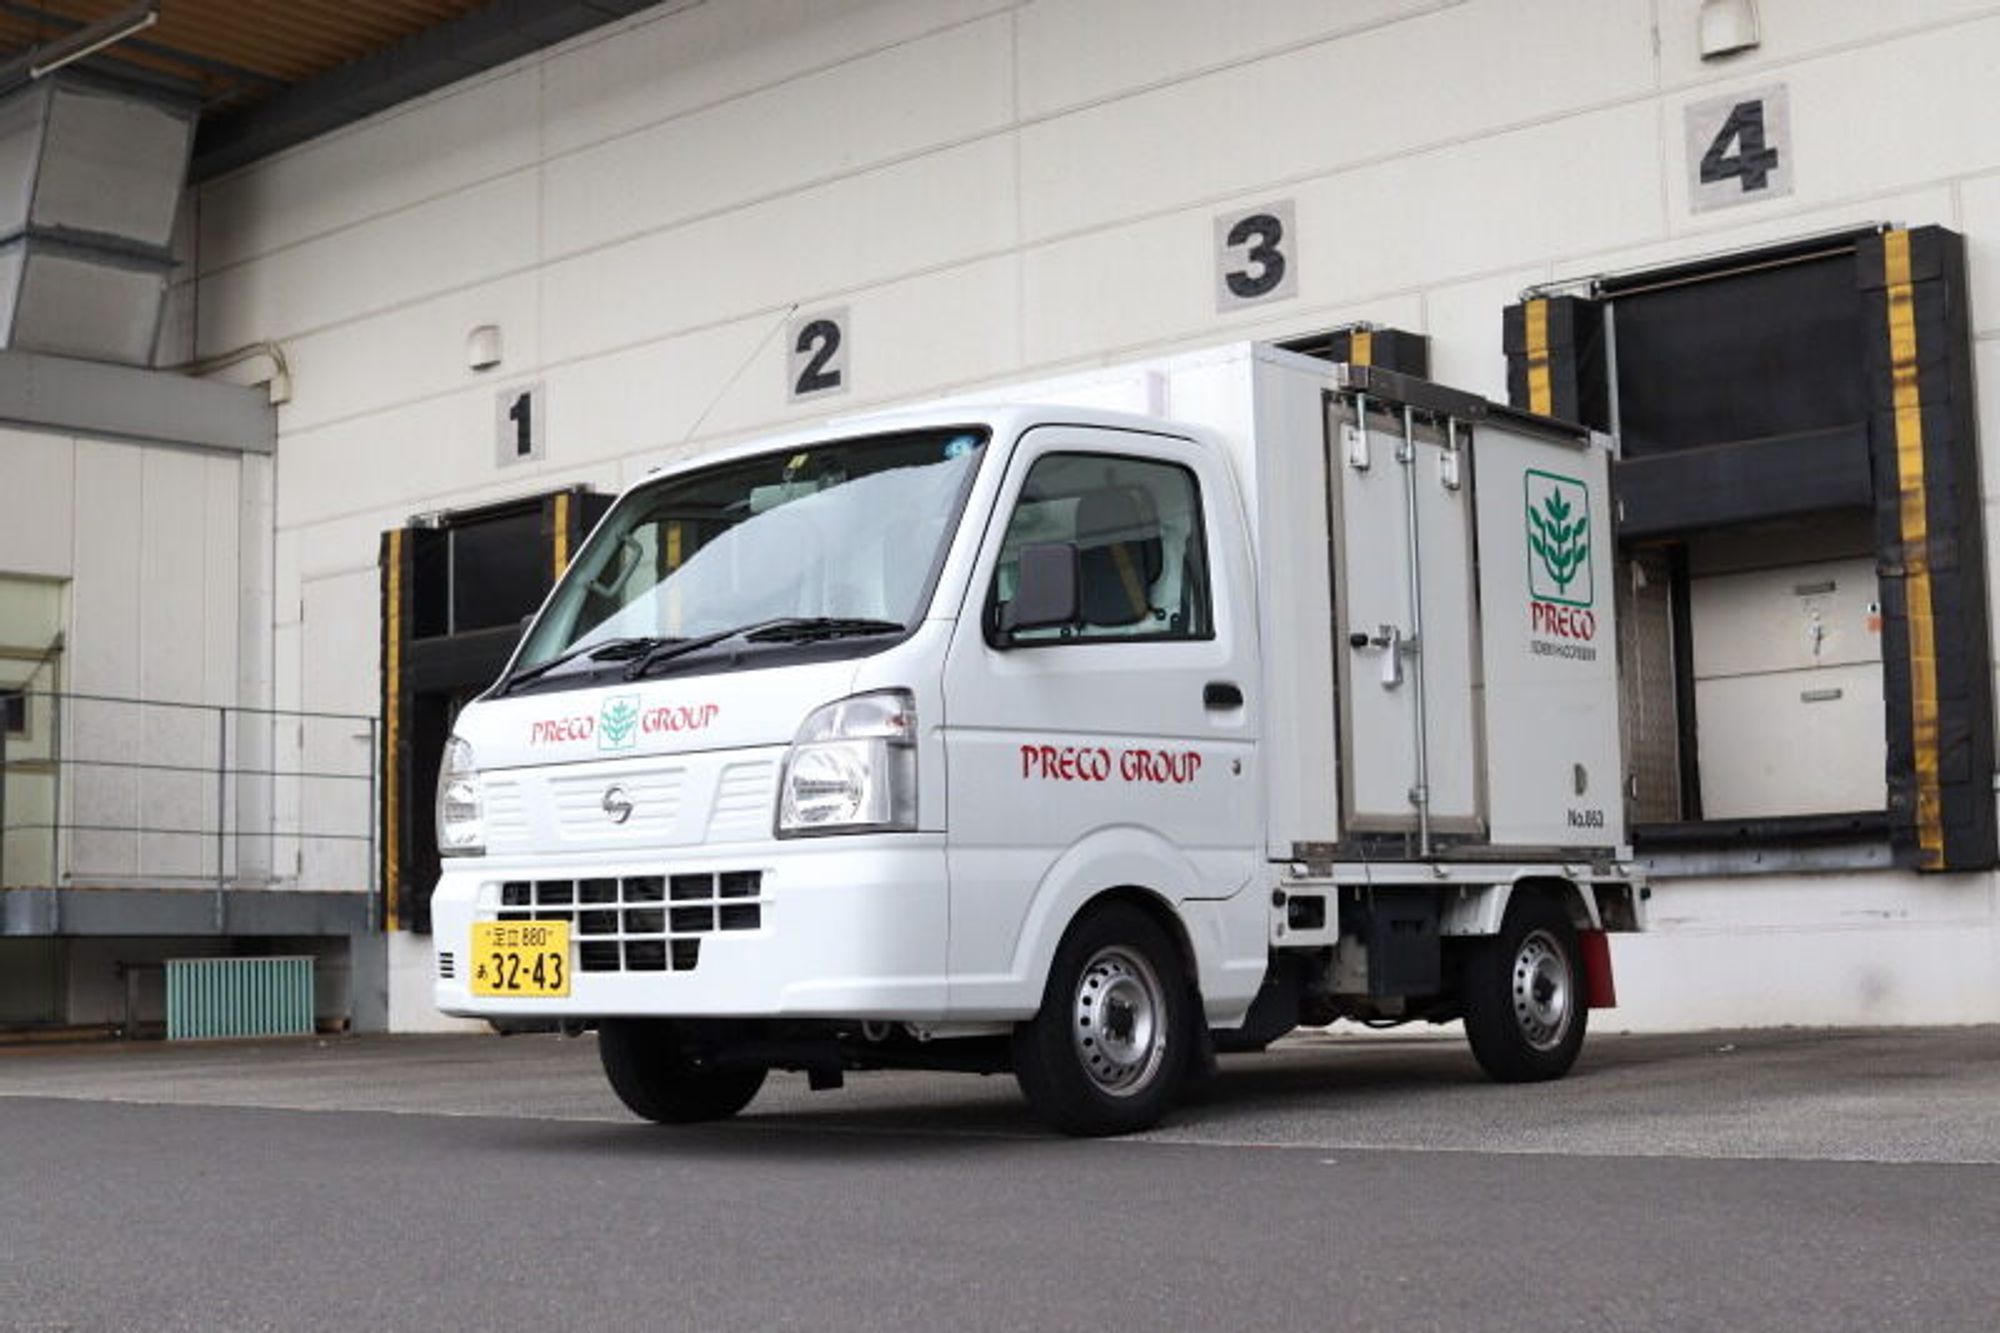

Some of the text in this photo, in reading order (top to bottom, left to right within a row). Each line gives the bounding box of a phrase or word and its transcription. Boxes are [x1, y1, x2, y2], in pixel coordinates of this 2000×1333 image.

[1700, 100, 1778, 192] 4
[1225, 214, 1285, 298] 3
[795, 320, 841, 395] 2
[510, 391, 531, 456] 1
[1531, 602, 1595, 641] PRECO
[530, 703, 719, 744] PRECO GROUP
[1020, 745, 1202, 783] PRECO GROUP
[491, 952, 562, 990] 32-43
